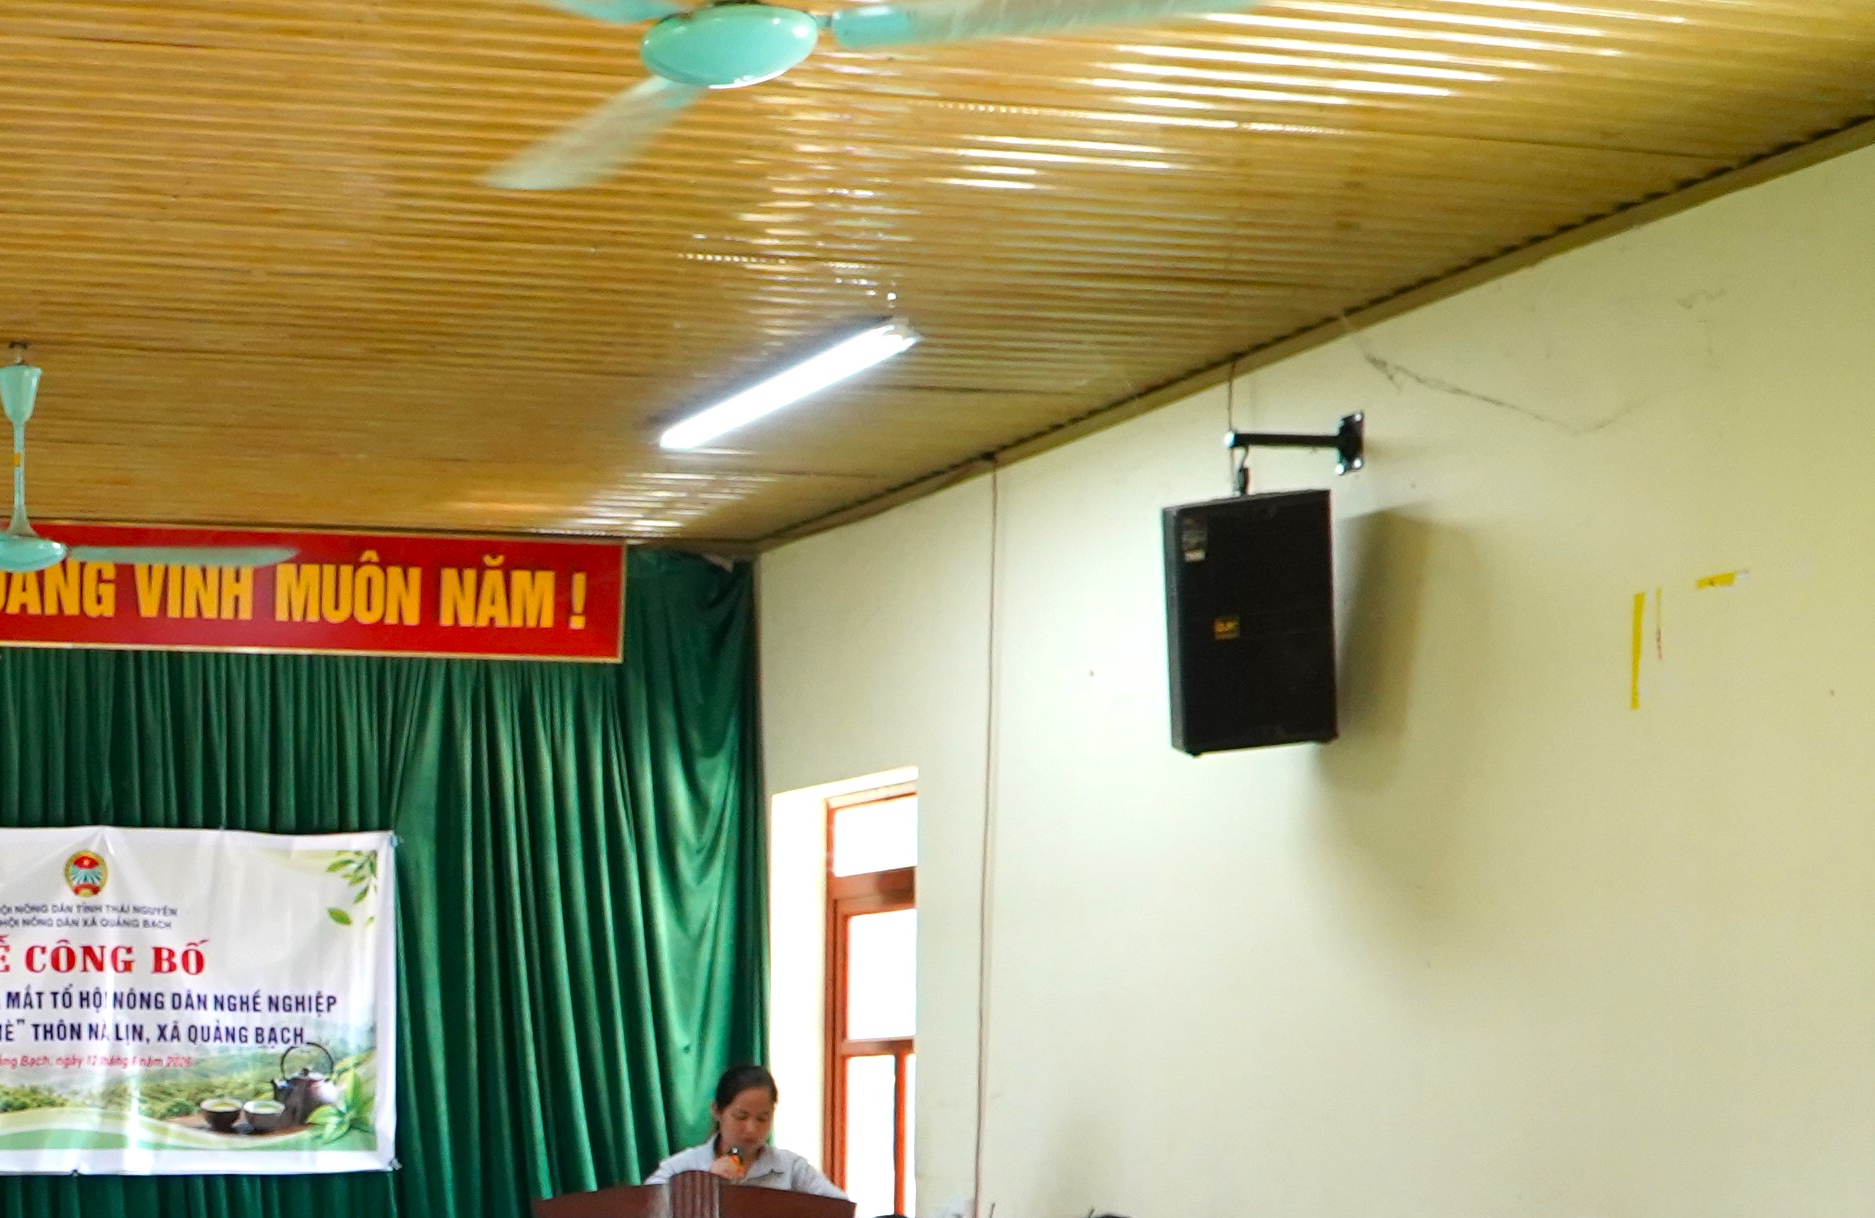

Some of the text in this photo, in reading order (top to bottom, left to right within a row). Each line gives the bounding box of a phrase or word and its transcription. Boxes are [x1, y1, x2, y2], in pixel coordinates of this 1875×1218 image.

[134, 563, 254, 621] VINH
[276, 549, 422, 626] MUÔN
[440, 554, 556, 628] NĂM
[24, 938, 136, 974] CÔNG
[151, 939, 211, 975] BỐ
[5, 985, 45, 1010] MẮT
[113, 987, 165, 1011] NÔNG
[171, 986, 209, 1012] DÂN
[267, 991, 338, 1018] NGHIỆP
[31, 1020, 82, 1042] THÔN
[156, 1020, 180, 1043] XÃ
[187, 1020, 249, 1044] QUẢNG
[254, 1026, 304, 1048] BẠCH
